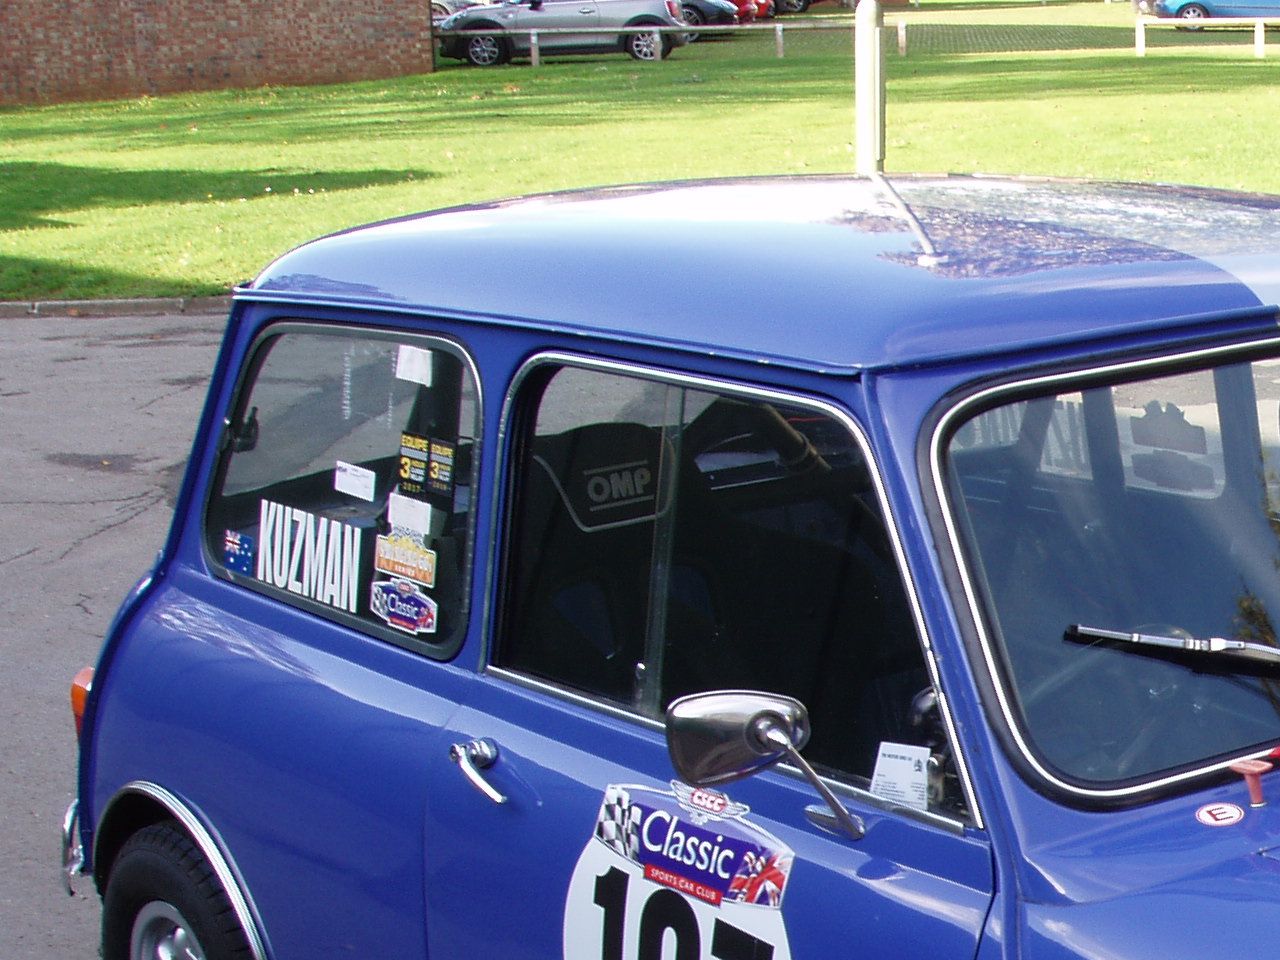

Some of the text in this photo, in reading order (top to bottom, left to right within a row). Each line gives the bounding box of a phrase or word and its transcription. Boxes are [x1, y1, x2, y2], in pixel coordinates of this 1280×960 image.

[587, 467, 652, 503] OMP
[257, 498, 362, 614] KUZMAN
[692, 793, 722, 812] CSCC
[1206, 807, 1234, 821] E
[641, 810, 736, 880] Classic
[650, 868, 717, 901] SPORTS CAR CLUB
